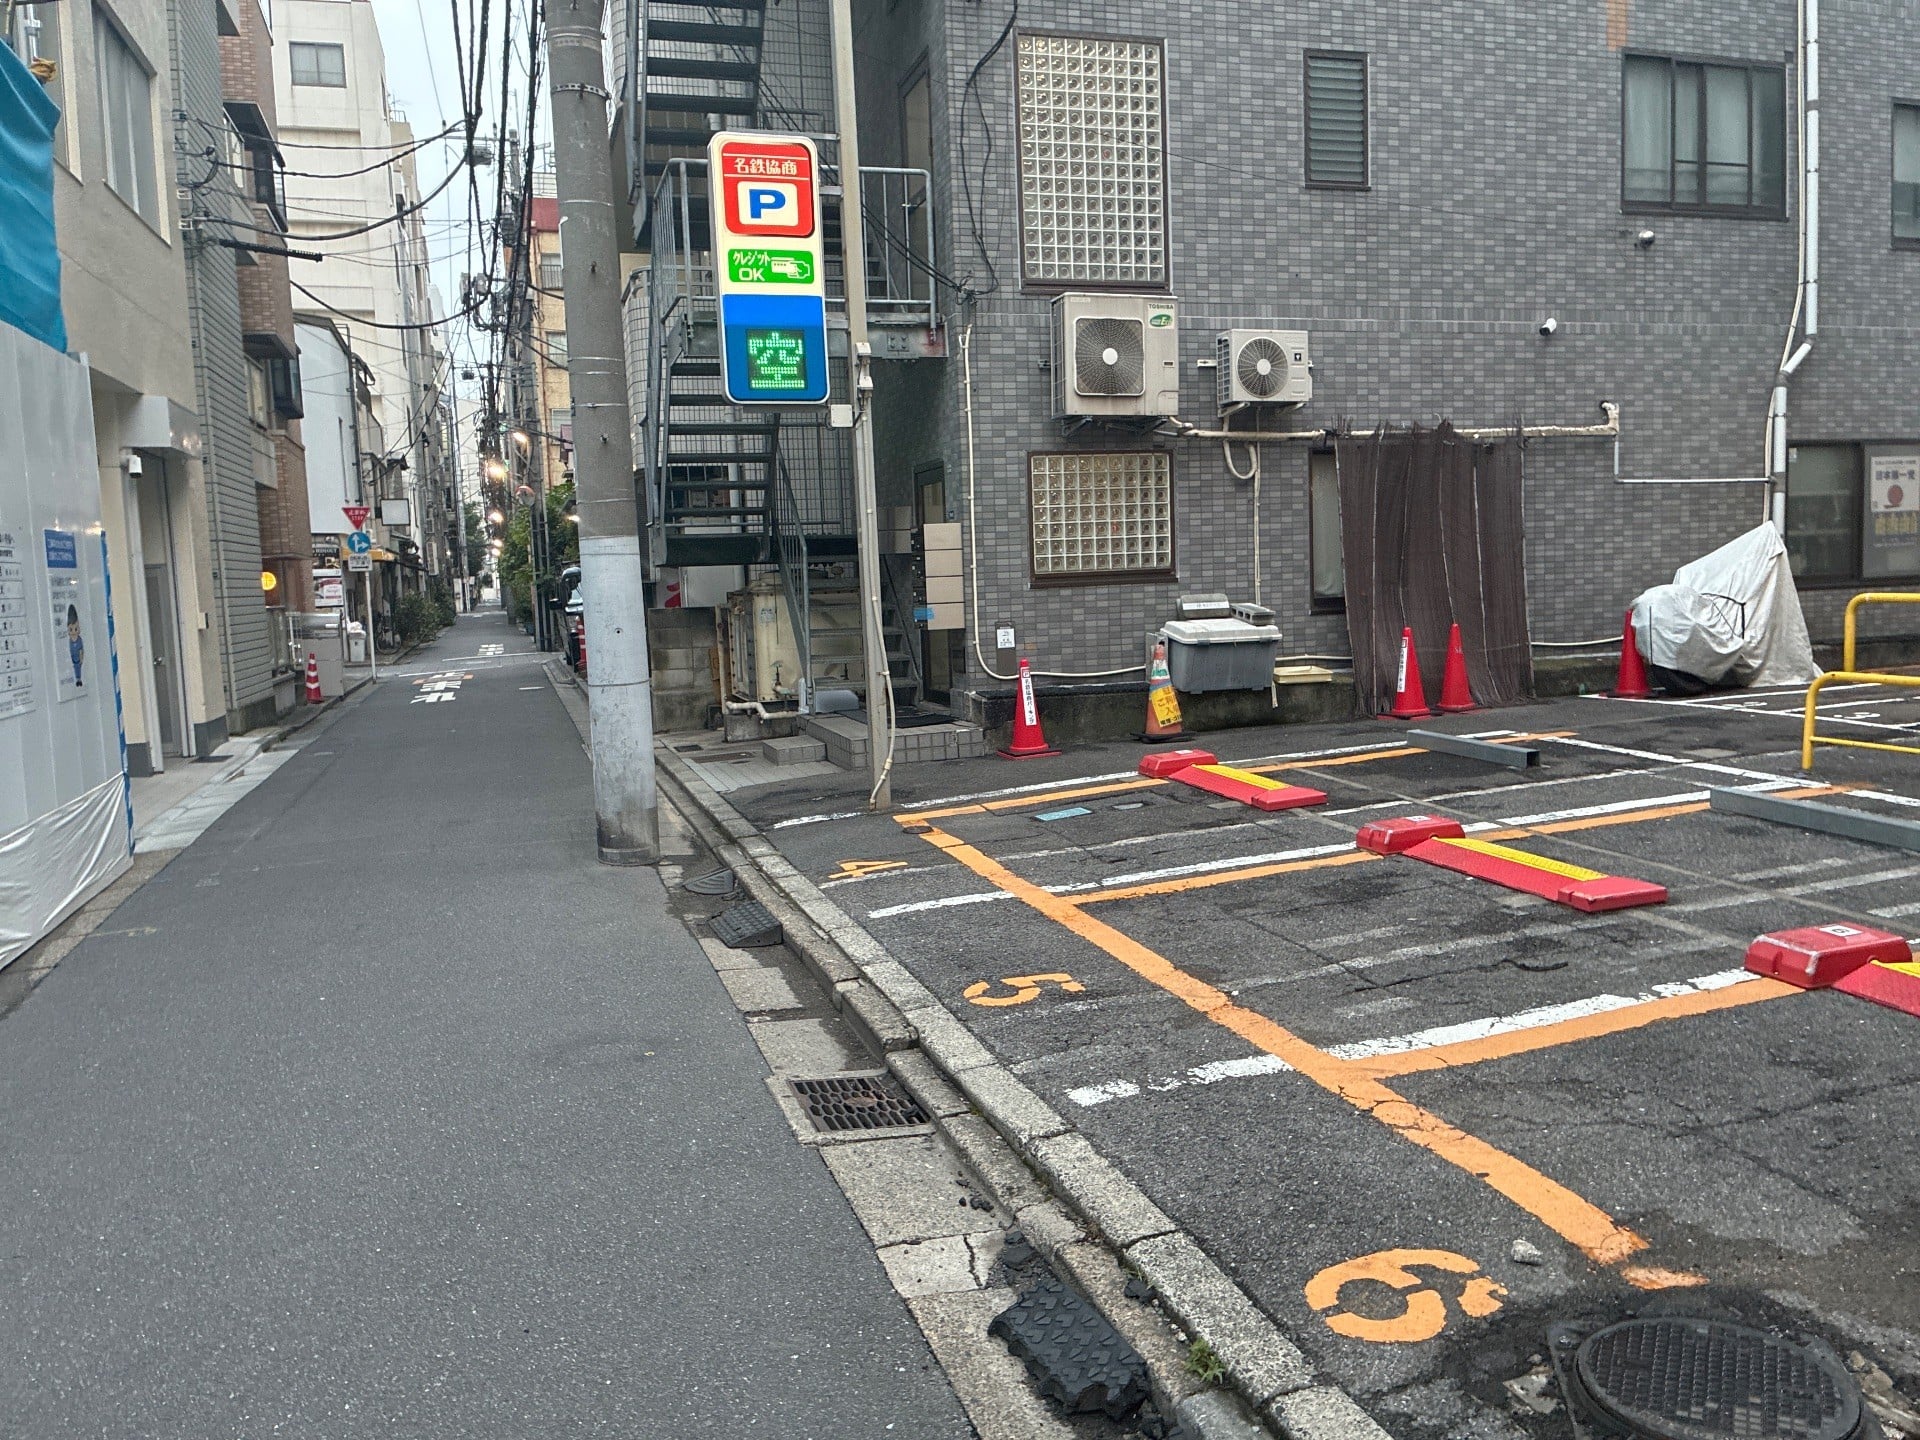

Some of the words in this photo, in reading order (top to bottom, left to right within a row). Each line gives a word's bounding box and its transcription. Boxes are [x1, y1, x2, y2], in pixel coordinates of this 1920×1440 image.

[733, 158, 798, 176] 名鉄協商
[748, 188, 787, 220] P
[732, 250, 772, 266] クレジット
[738, 266, 766, 282] OK
[748, 331, 807, 389] 空
[827, 859, 909, 879] 4
[962, 972, 1086, 1008] 5
[1304, 1248, 1509, 1343] 6
